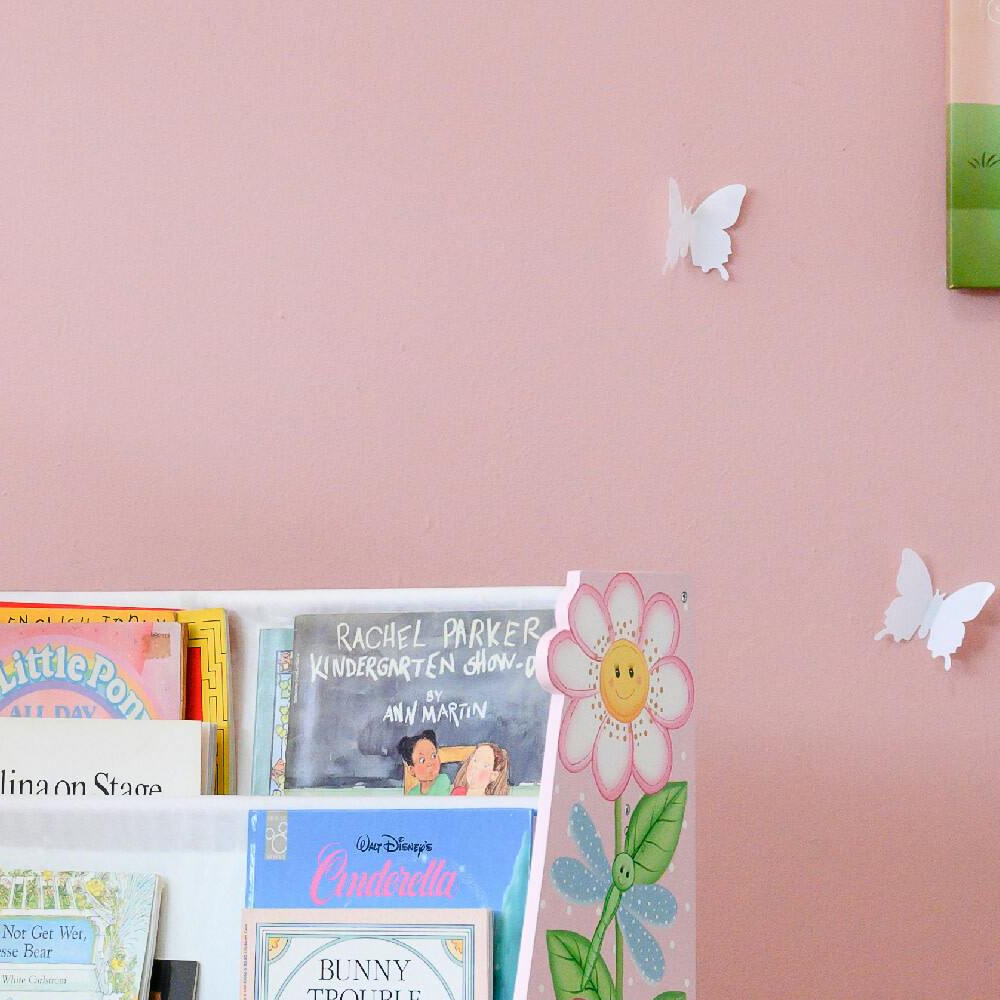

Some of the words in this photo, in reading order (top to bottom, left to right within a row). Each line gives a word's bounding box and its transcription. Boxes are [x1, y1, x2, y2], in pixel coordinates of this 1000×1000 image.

[337, 620, 427, 651] RACHEL
[444, 617, 541, 648] PARKER
[310, 653, 455, 682] KINDERGARTEN
[88, 654, 151, 720] Pon
[427, 690, 442, 702] BY
[383, 702, 416, 725] ANN
[422, 701, 488, 727] MARTIN
[54, 777, 86, 795] on
[310, 842, 460, 906] Cinderella
[2, 925, 25, 939] Not
[31, 925, 54, 939] Get
[60, 926, 87, 941] Wet,
[24, 945, 53, 958] Bear
[319, 958, 411, 980] BUNNY
